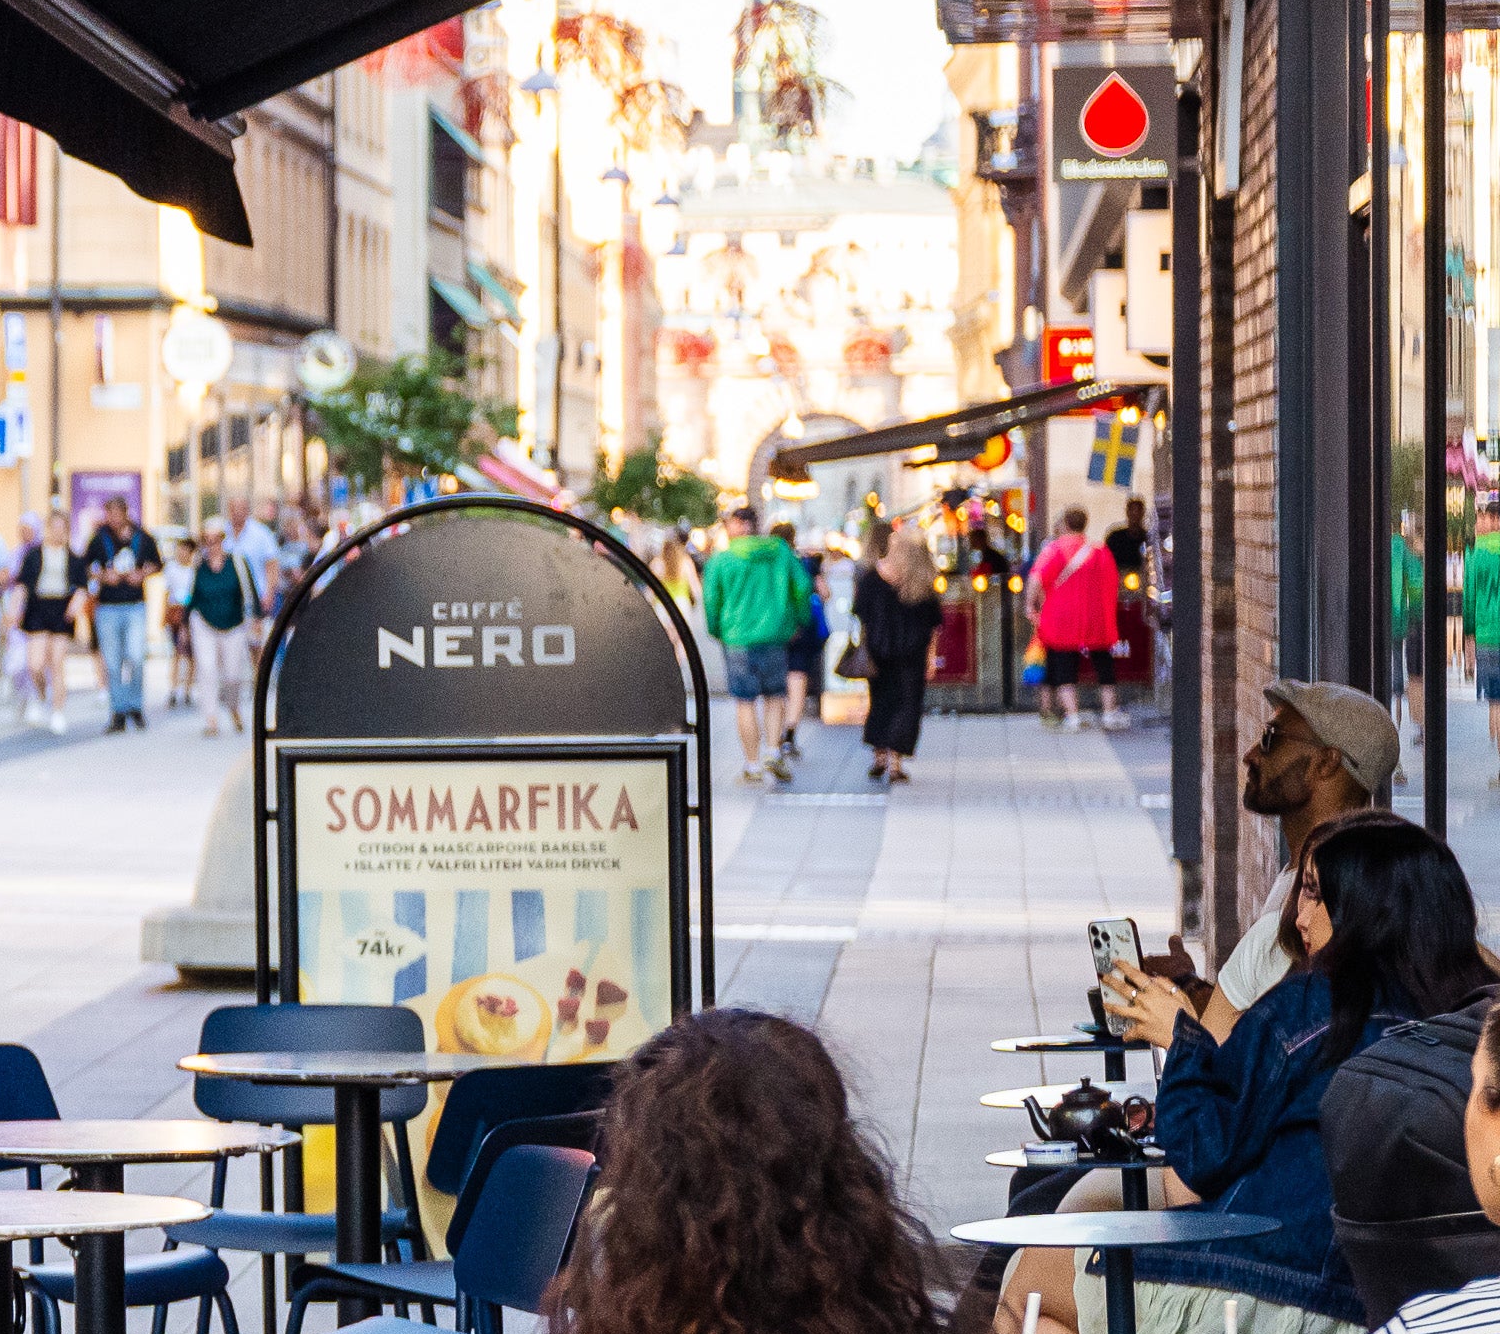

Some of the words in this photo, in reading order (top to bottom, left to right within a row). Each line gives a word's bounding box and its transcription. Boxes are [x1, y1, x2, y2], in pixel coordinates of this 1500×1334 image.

[378, 625, 576, 668] NERO
[325, 784, 639, 834] SOMMARFIKA
[541, 841, 607, 854] BAKELSE
[354, 859, 411, 871] ISLATTE
[480, 858, 522, 871] LITEN
[528, 858, 567, 871] VARM
[571, 858, 622, 871] DRYCK
[357, 939, 406, 957] 74kr
